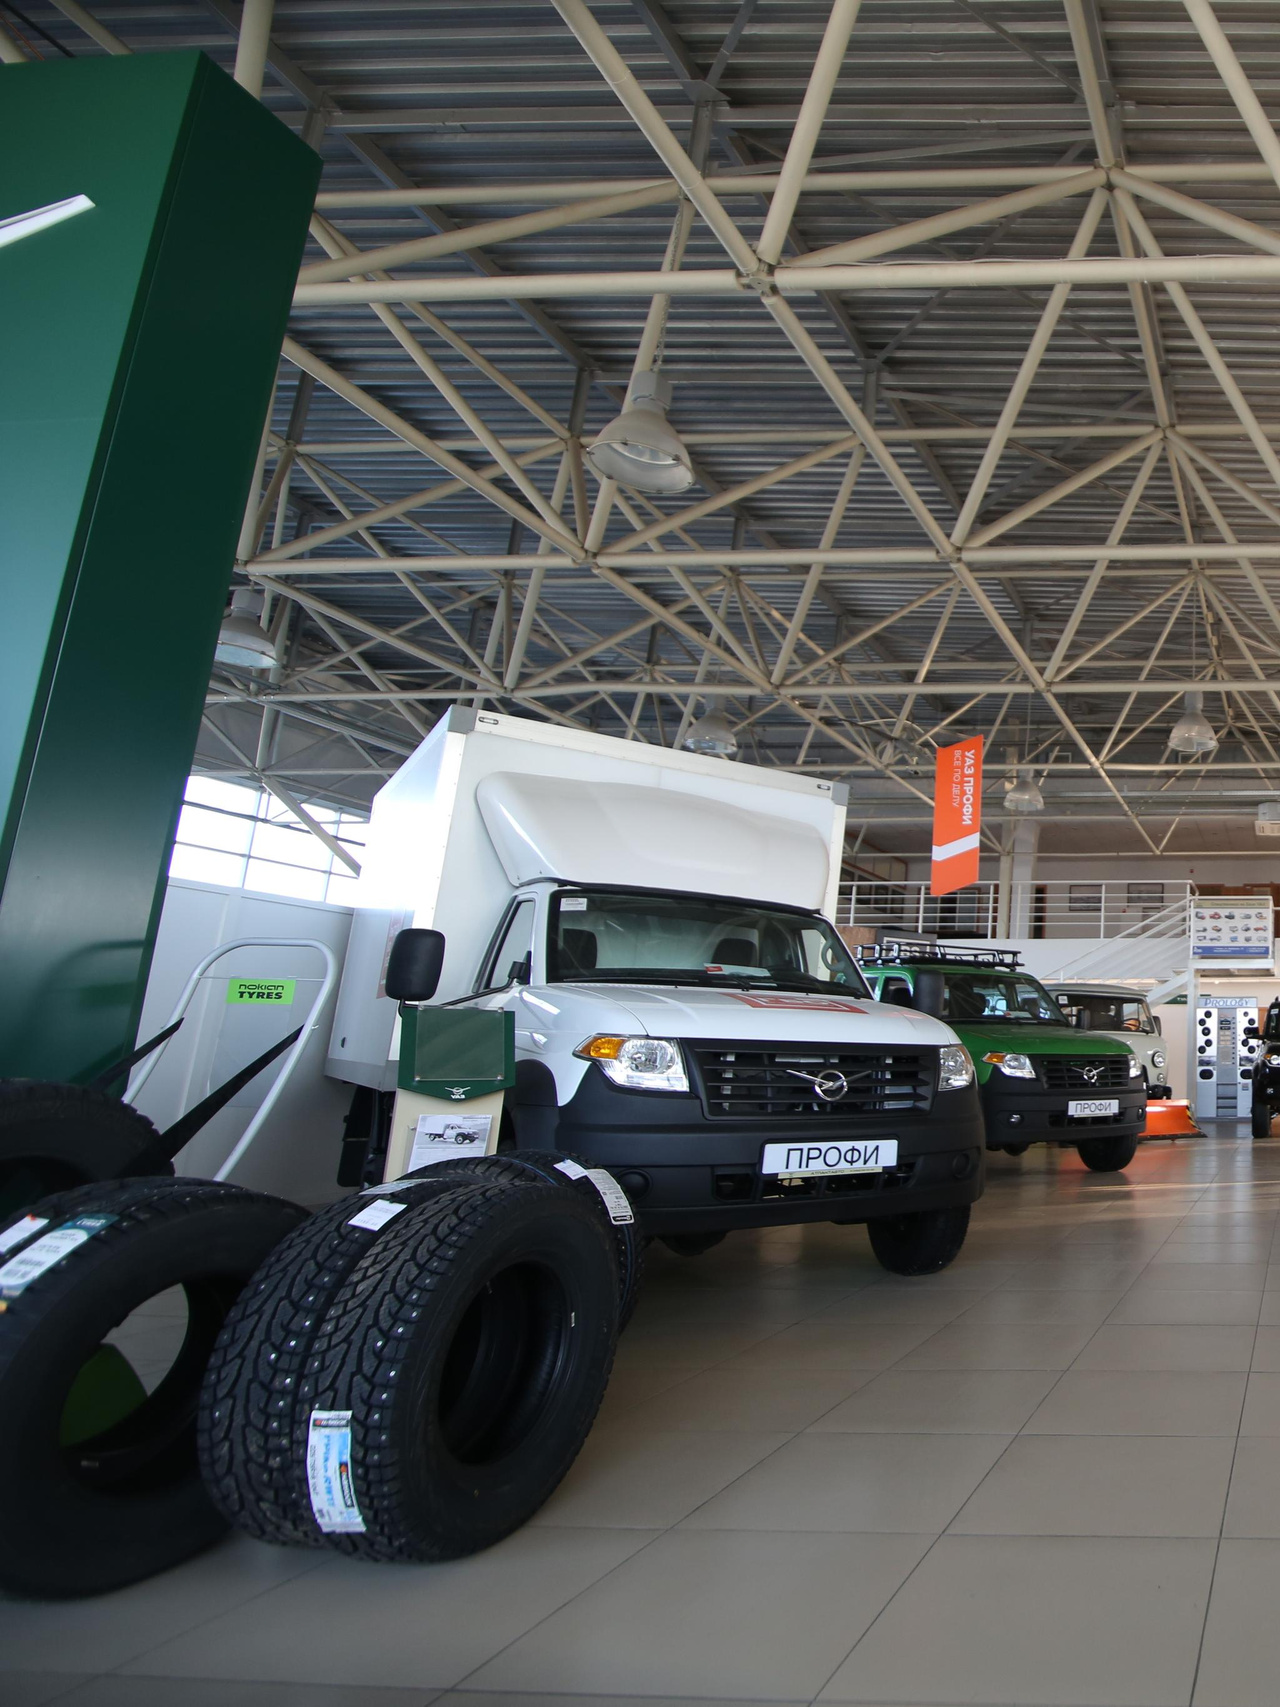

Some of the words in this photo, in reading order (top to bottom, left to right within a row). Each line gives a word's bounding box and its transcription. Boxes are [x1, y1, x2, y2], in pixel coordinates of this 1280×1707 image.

[953, 749, 962, 767] ВСЕ
[964, 749, 975, 775] УАЗ
[953, 768, 961, 782] ПО
[952, 783, 961, 808] ДЕЛУ
[962, 777, 974, 825] ПРОФИ
[238, 991, 283, 1000] TYRES
[1075, 1101, 1112, 1113] ПРОФИ
[785, 1145, 880, 1170] ПРОФИ
